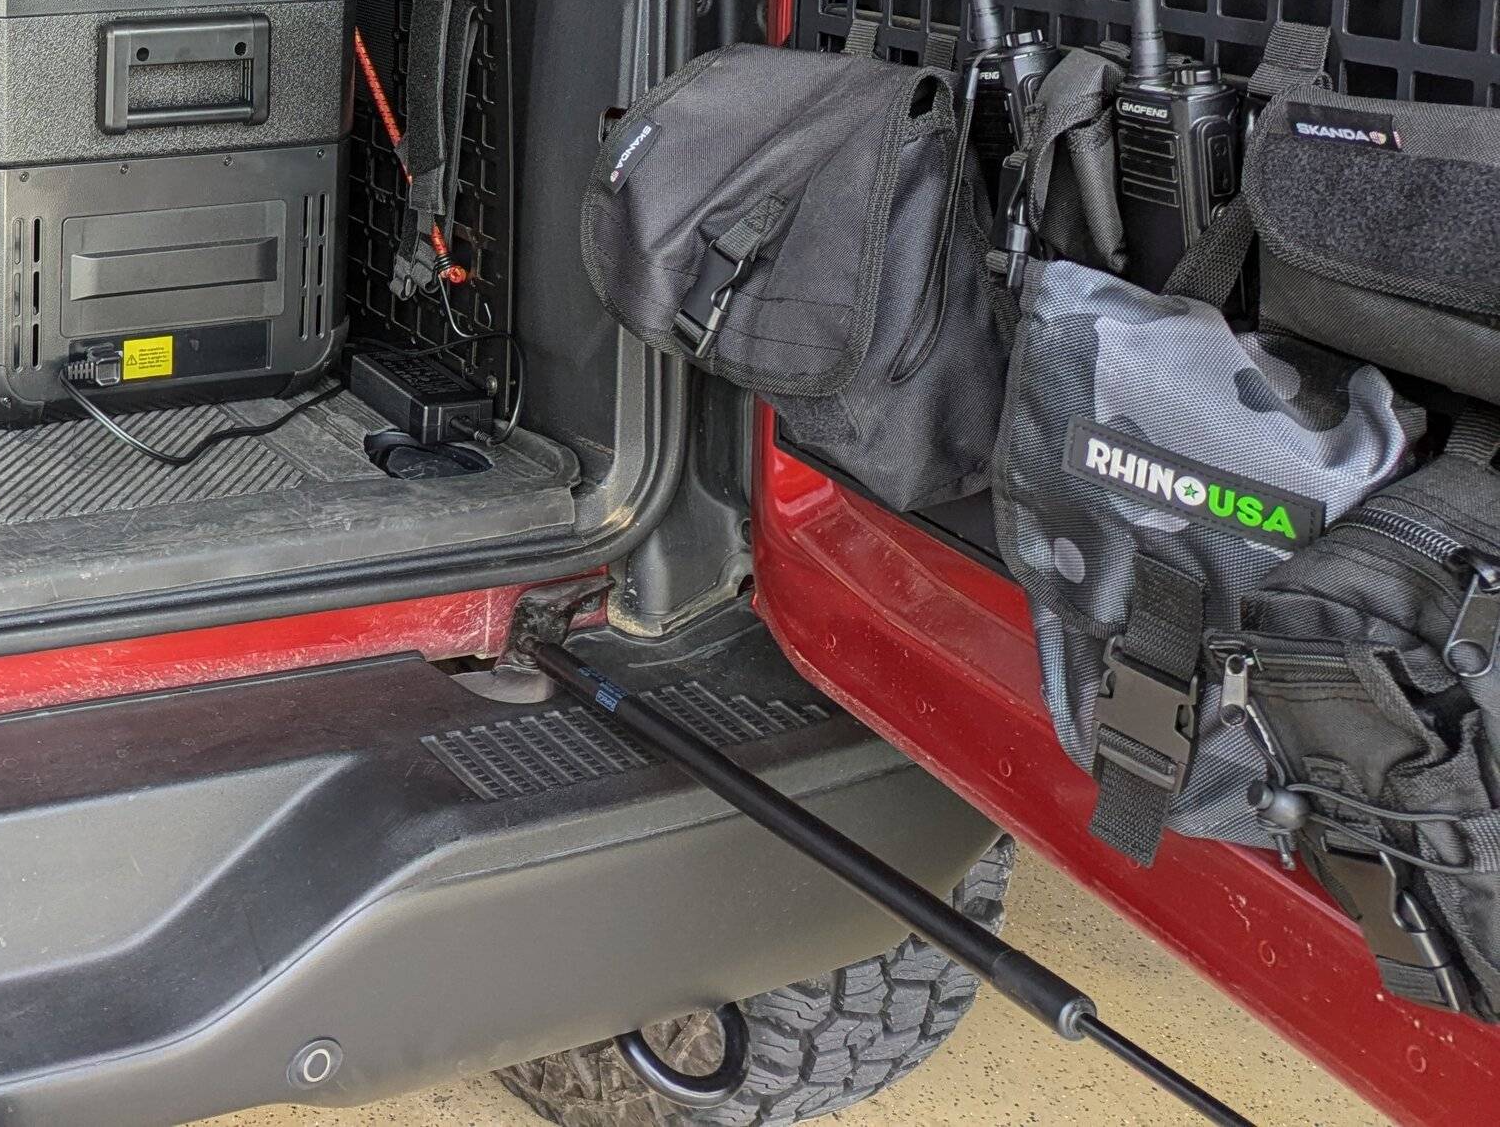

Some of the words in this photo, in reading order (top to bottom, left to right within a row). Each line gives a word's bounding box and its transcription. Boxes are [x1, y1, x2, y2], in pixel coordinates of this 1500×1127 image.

[1121, 101, 1168, 119] BAOFENG
[1295, 122, 1371, 142] SKANDA
[614, 125, 652, 169] SKANDA
